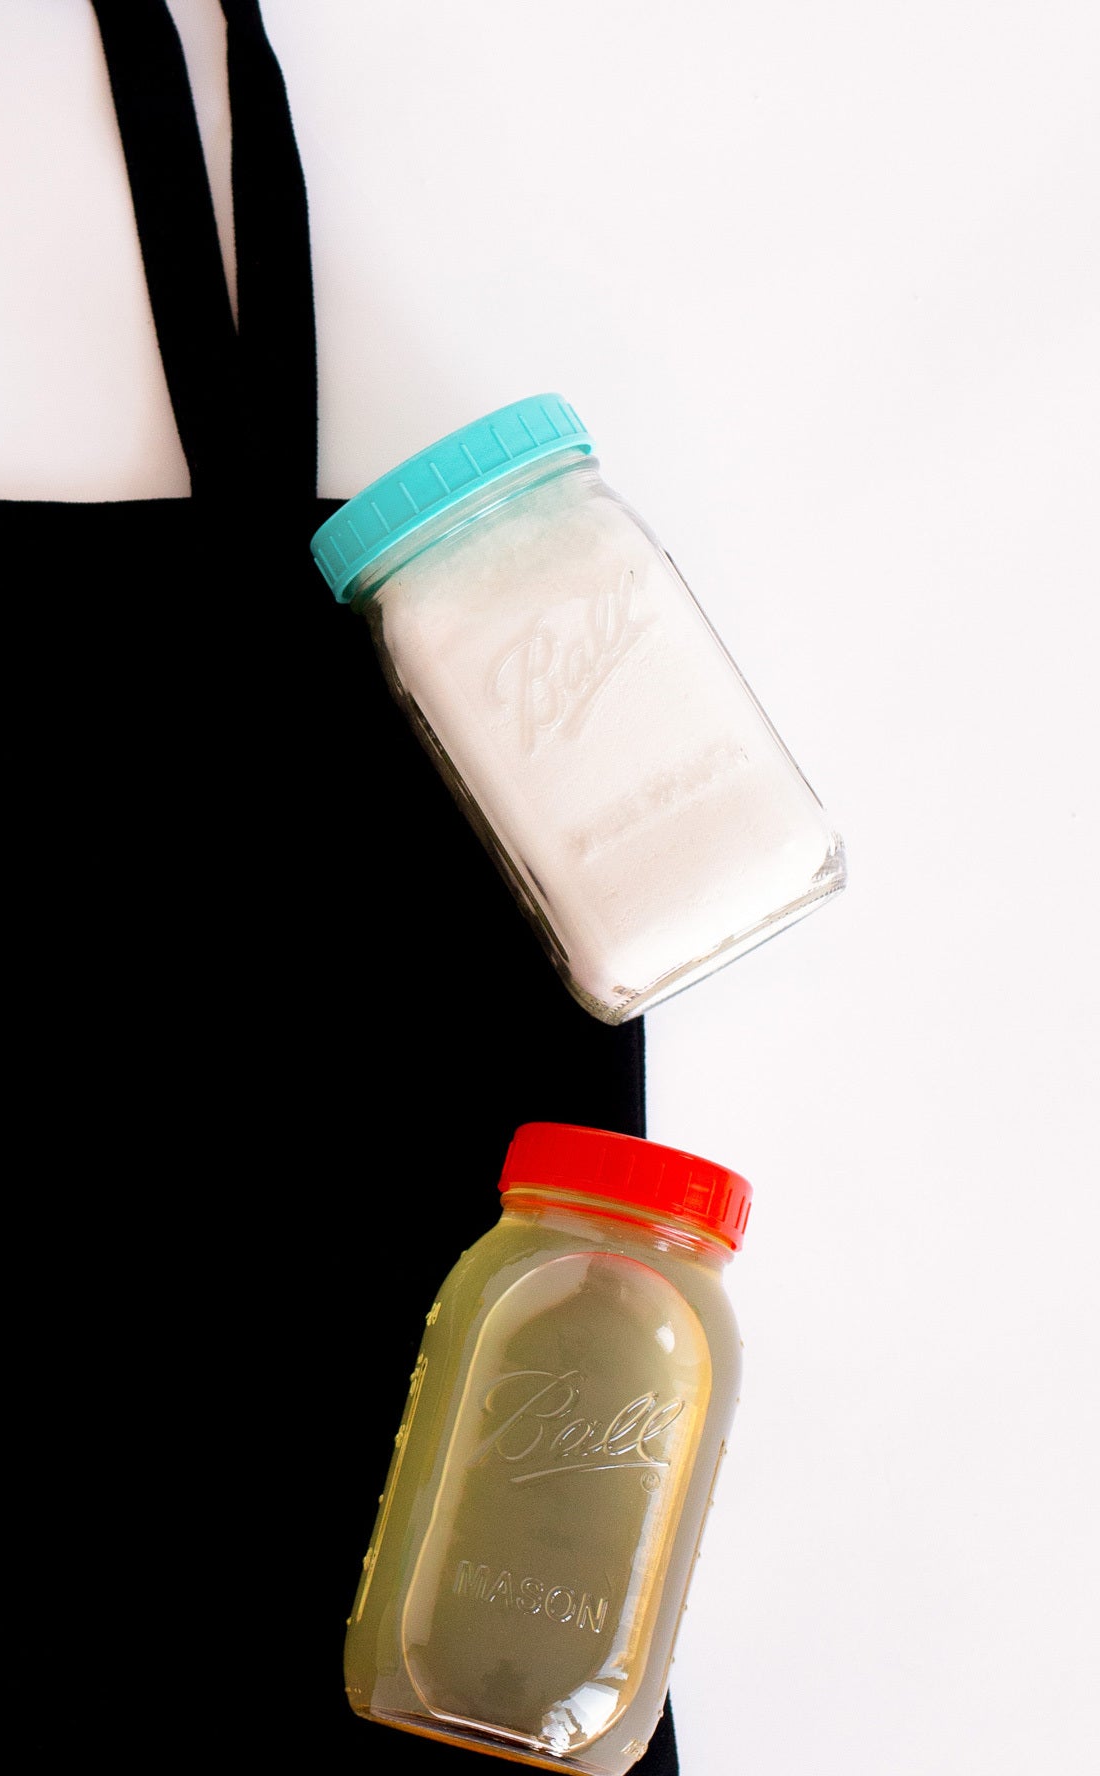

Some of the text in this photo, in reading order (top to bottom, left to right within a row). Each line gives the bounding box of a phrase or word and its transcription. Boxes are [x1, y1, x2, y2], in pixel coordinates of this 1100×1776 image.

[484, 567, 656, 758] Ball
[470, 1369, 685, 1483] Ball
[452, 1559, 609, 1634] MASON
